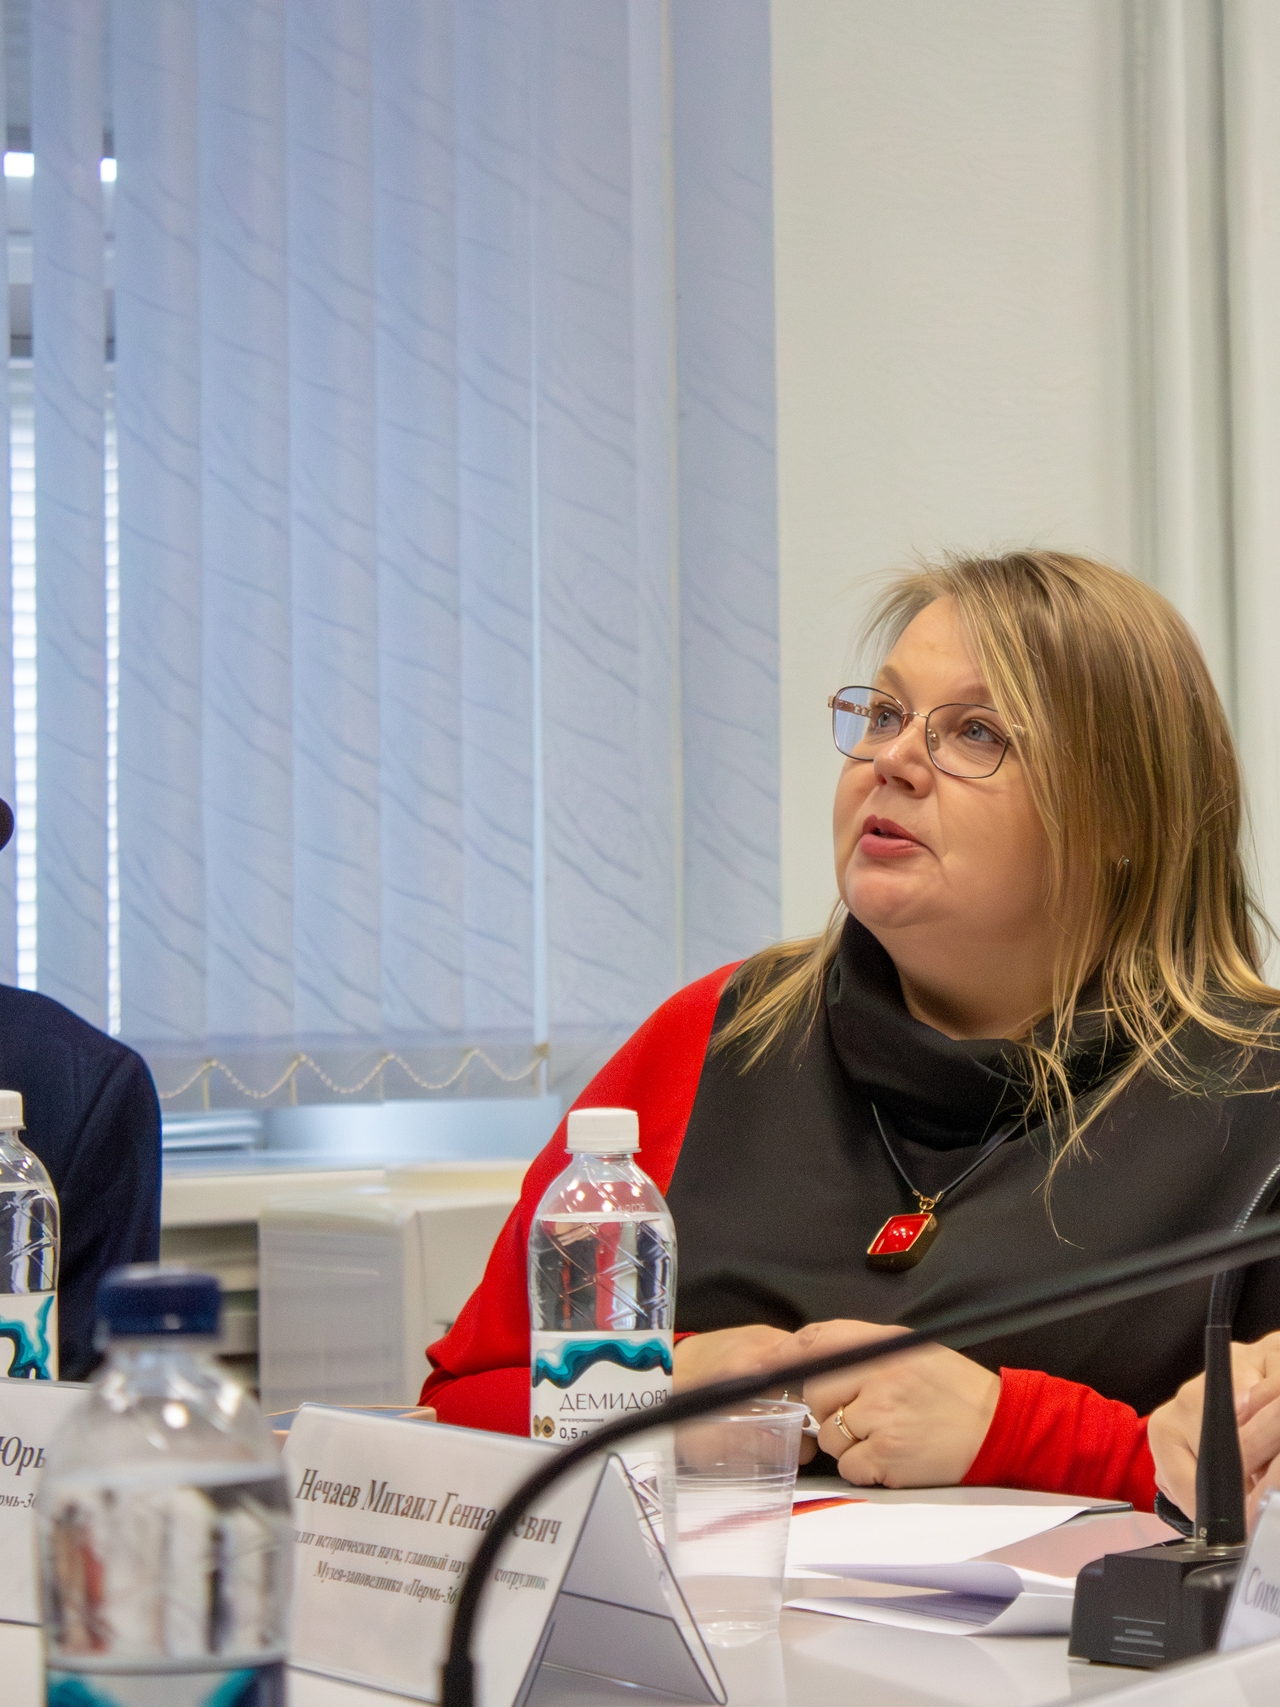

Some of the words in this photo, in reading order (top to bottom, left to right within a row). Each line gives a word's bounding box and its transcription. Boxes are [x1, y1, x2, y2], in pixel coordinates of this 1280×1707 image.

[0, 1436, 46, 1476] Юрь
[560, 1427, 578, 1441] 0,5
[295, 1468, 361, 1509] Нечаев
[361, 1479, 437, 1522] Михаил
[436, 1492, 562, 1545] Геннаевич
[313, 1560, 403, 1593] Музея-заповедника
[404, 1578, 460, 1605] «Пермь-36
[315, 1535, 378, 1556] исторических
[377, 1546, 403, 1565] наук,
[404, 1553, 449, 1571] главный
[494, 1569, 549, 1591] сотрудник
